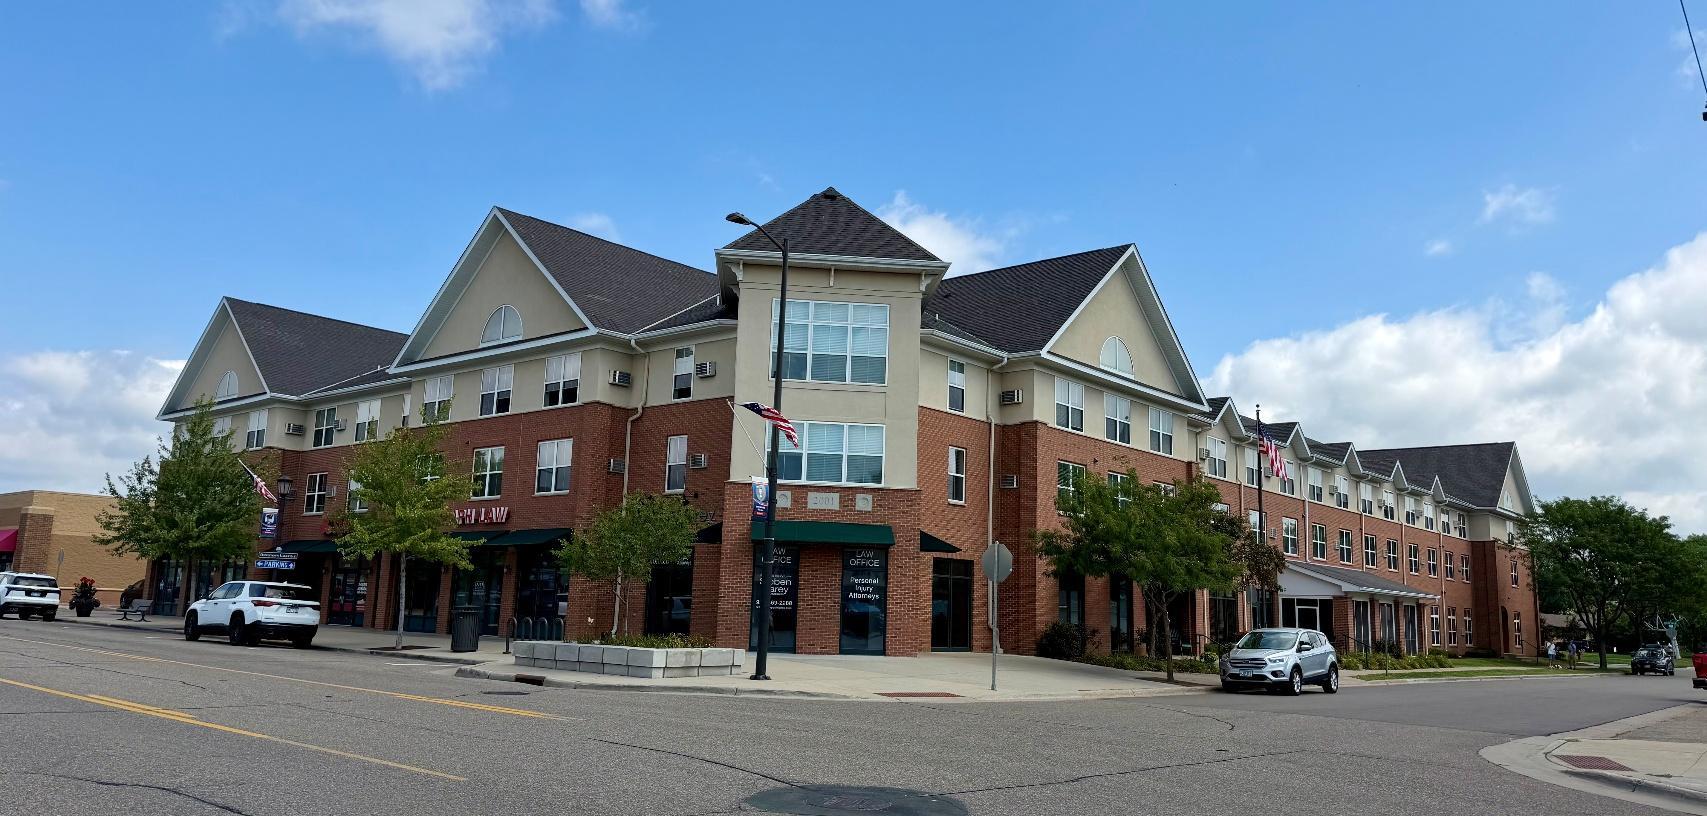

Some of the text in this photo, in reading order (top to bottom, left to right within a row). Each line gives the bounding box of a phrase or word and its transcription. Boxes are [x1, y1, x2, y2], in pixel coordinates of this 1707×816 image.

[479, 506, 509, 523] LAW
[856, 550, 874, 558] LAW
[849, 558, 880, 567] OFFICE
[850, 576, 879, 584] Personal
[855, 584, 874, 593] Injury
[848, 592, 880, 601] Attorneys
